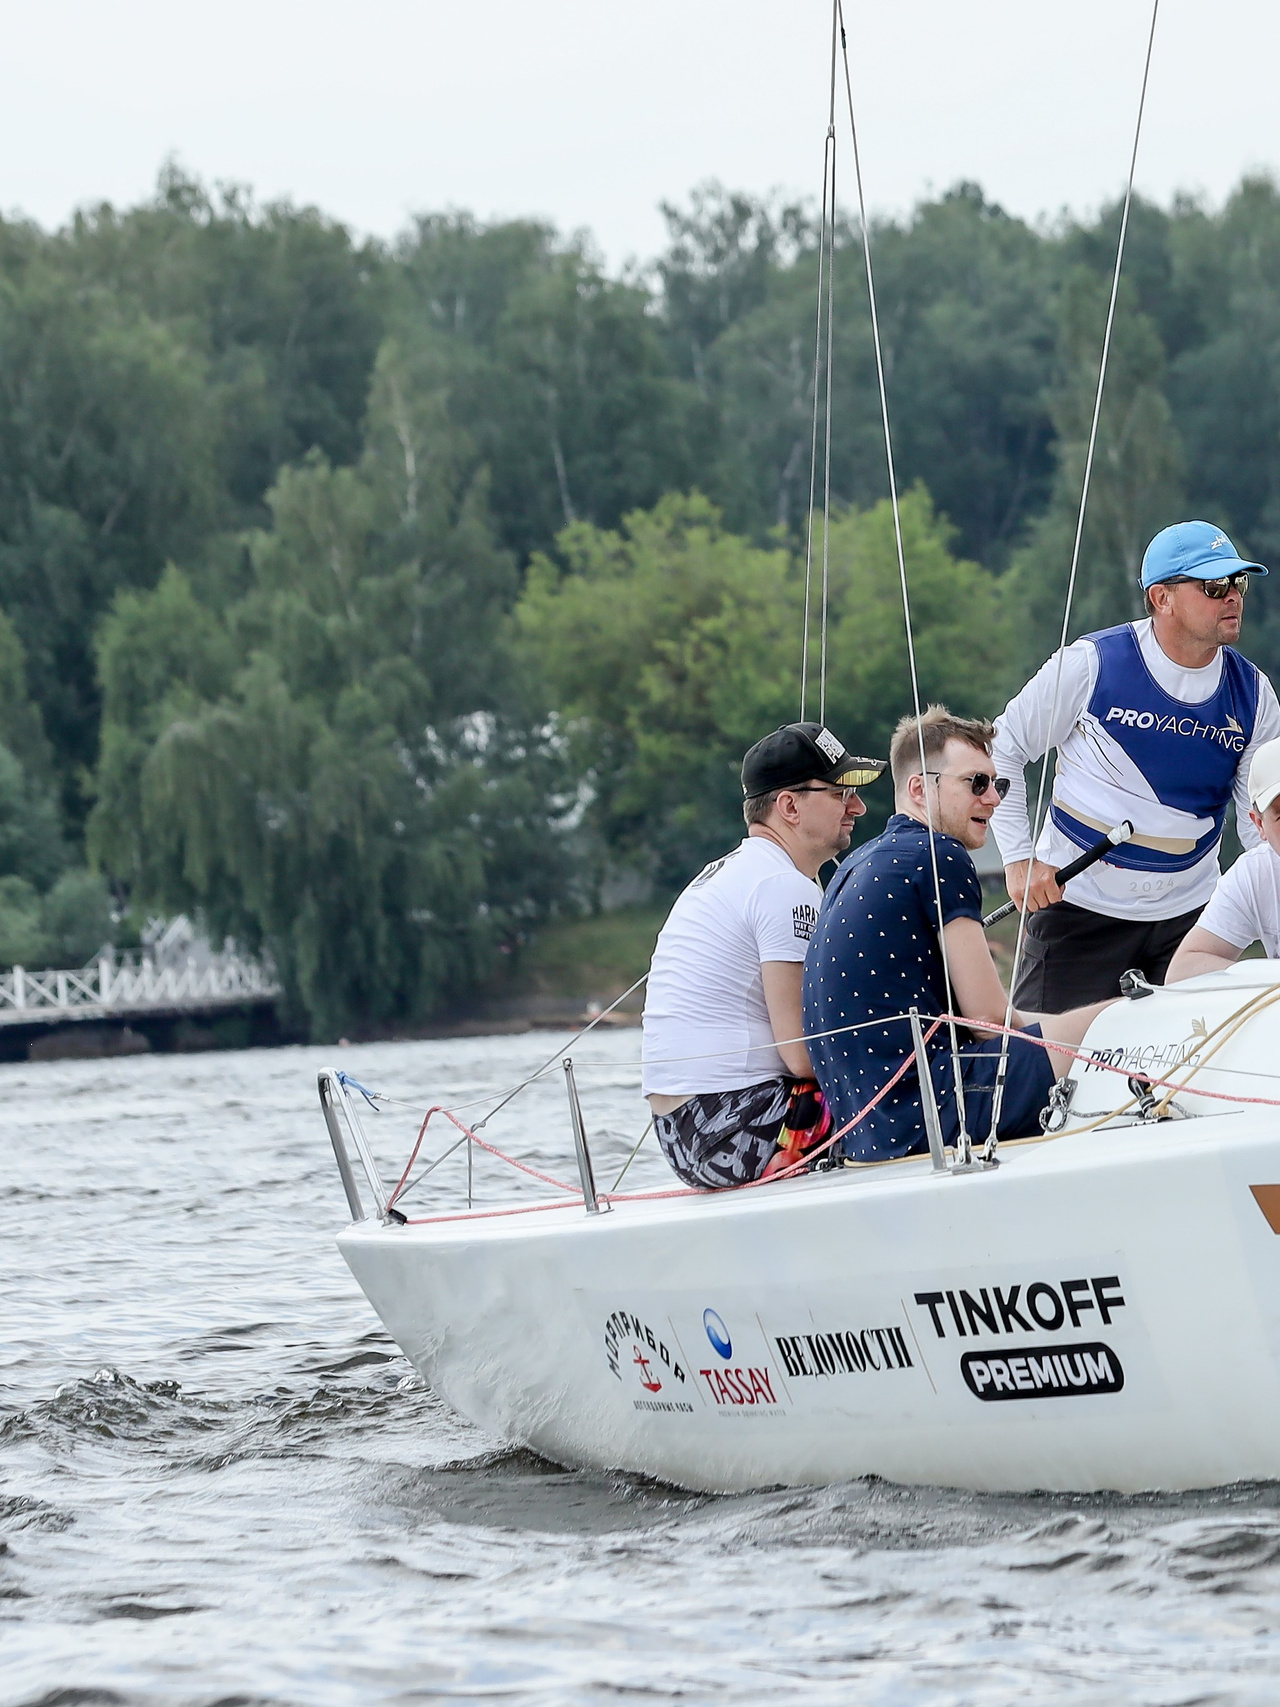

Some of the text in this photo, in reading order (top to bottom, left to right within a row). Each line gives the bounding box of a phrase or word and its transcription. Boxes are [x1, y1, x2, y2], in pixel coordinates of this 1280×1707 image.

[1105, 706, 1246, 753] PROYACHTING
[1129, 878, 1174, 893] 2024
[1084, 1043, 1201, 1073] PROYACHTING
[914, 1276, 1126, 1338] TINKOFF
[604, 1310, 686, 1384] МОРПРИБОР
[774, 1326, 915, 1382] ВЕДОМОСТИ
[699, 1367, 777, 1405] TASSAY
[968, 1351, 1115, 1392] PREMIUM
